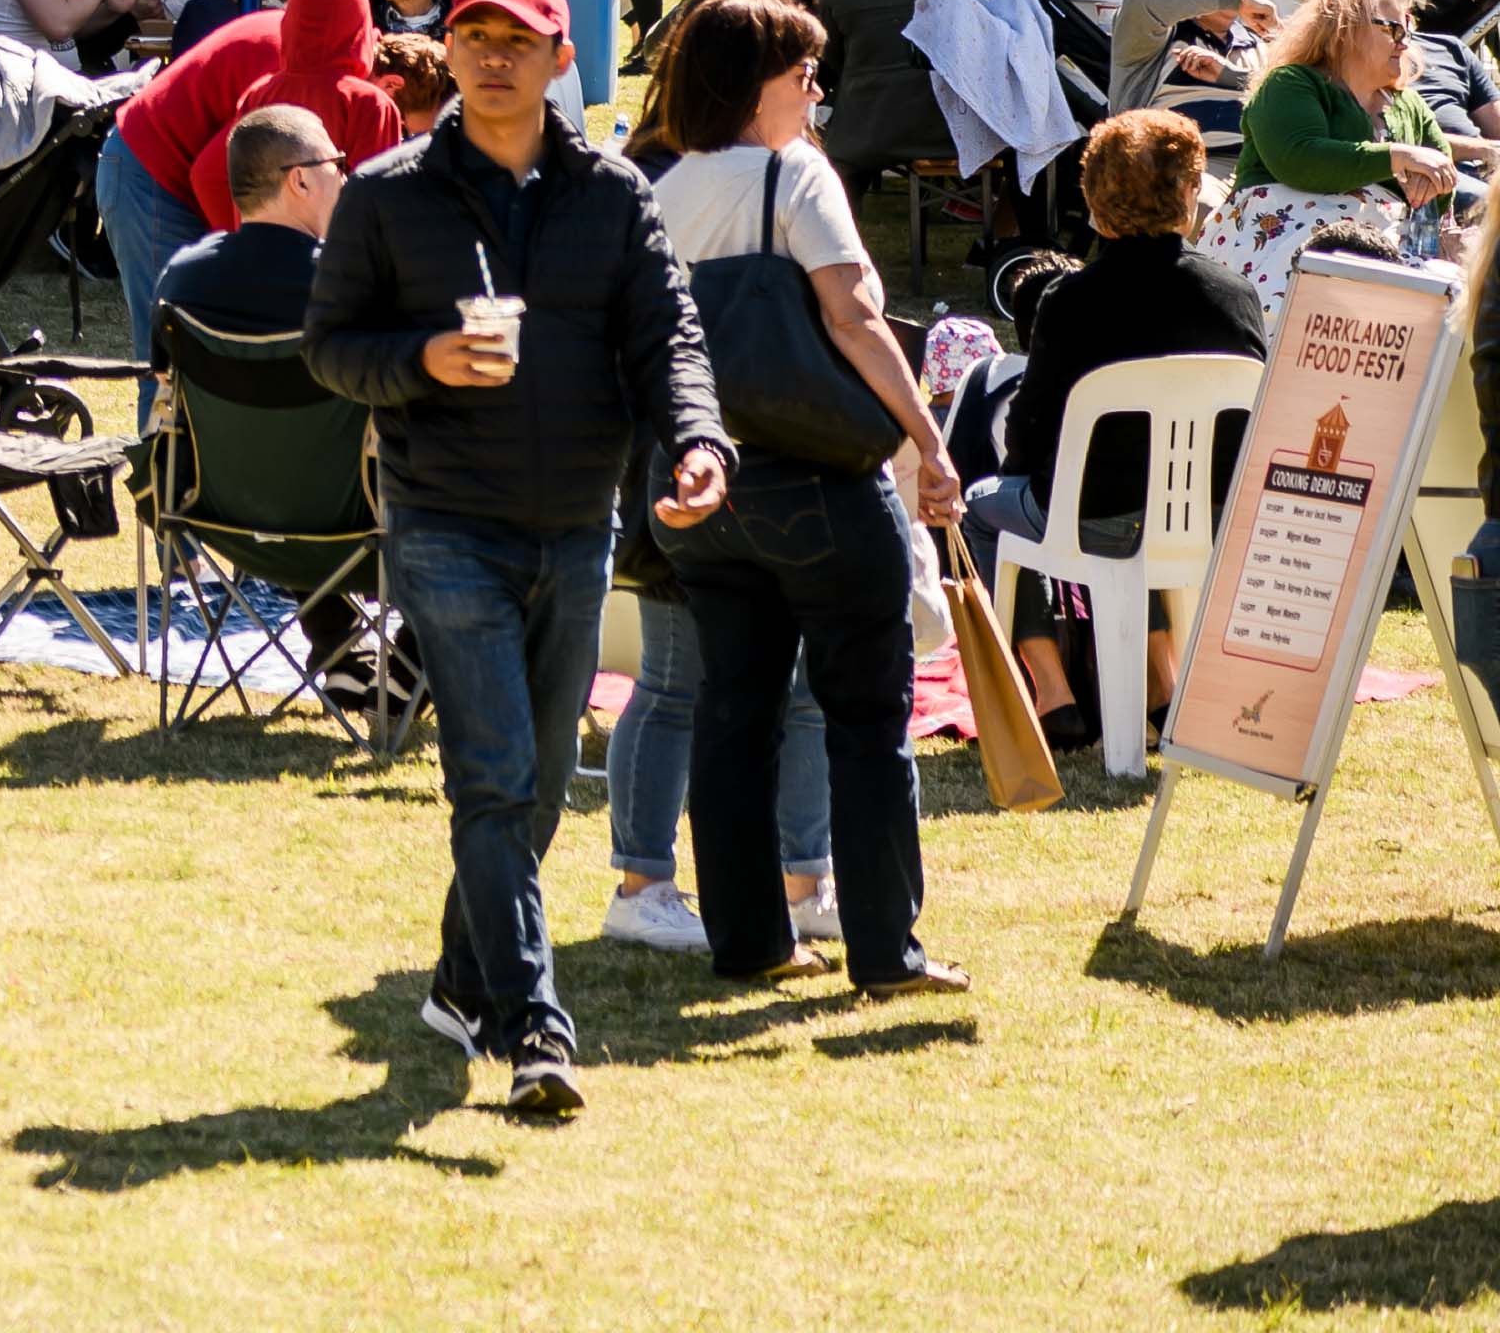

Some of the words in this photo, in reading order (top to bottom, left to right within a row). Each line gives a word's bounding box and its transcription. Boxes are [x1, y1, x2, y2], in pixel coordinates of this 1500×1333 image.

[1310, 314, 1408, 351] PARKLANDS
[1302, 342, 1352, 374] FOOD
[1353, 350, 1400, 382] FEST
[1271, 469, 1310, 492] COOKING
[1310, 475, 1337, 496] DEMO
[1336, 480, 1365, 501] STAGE
